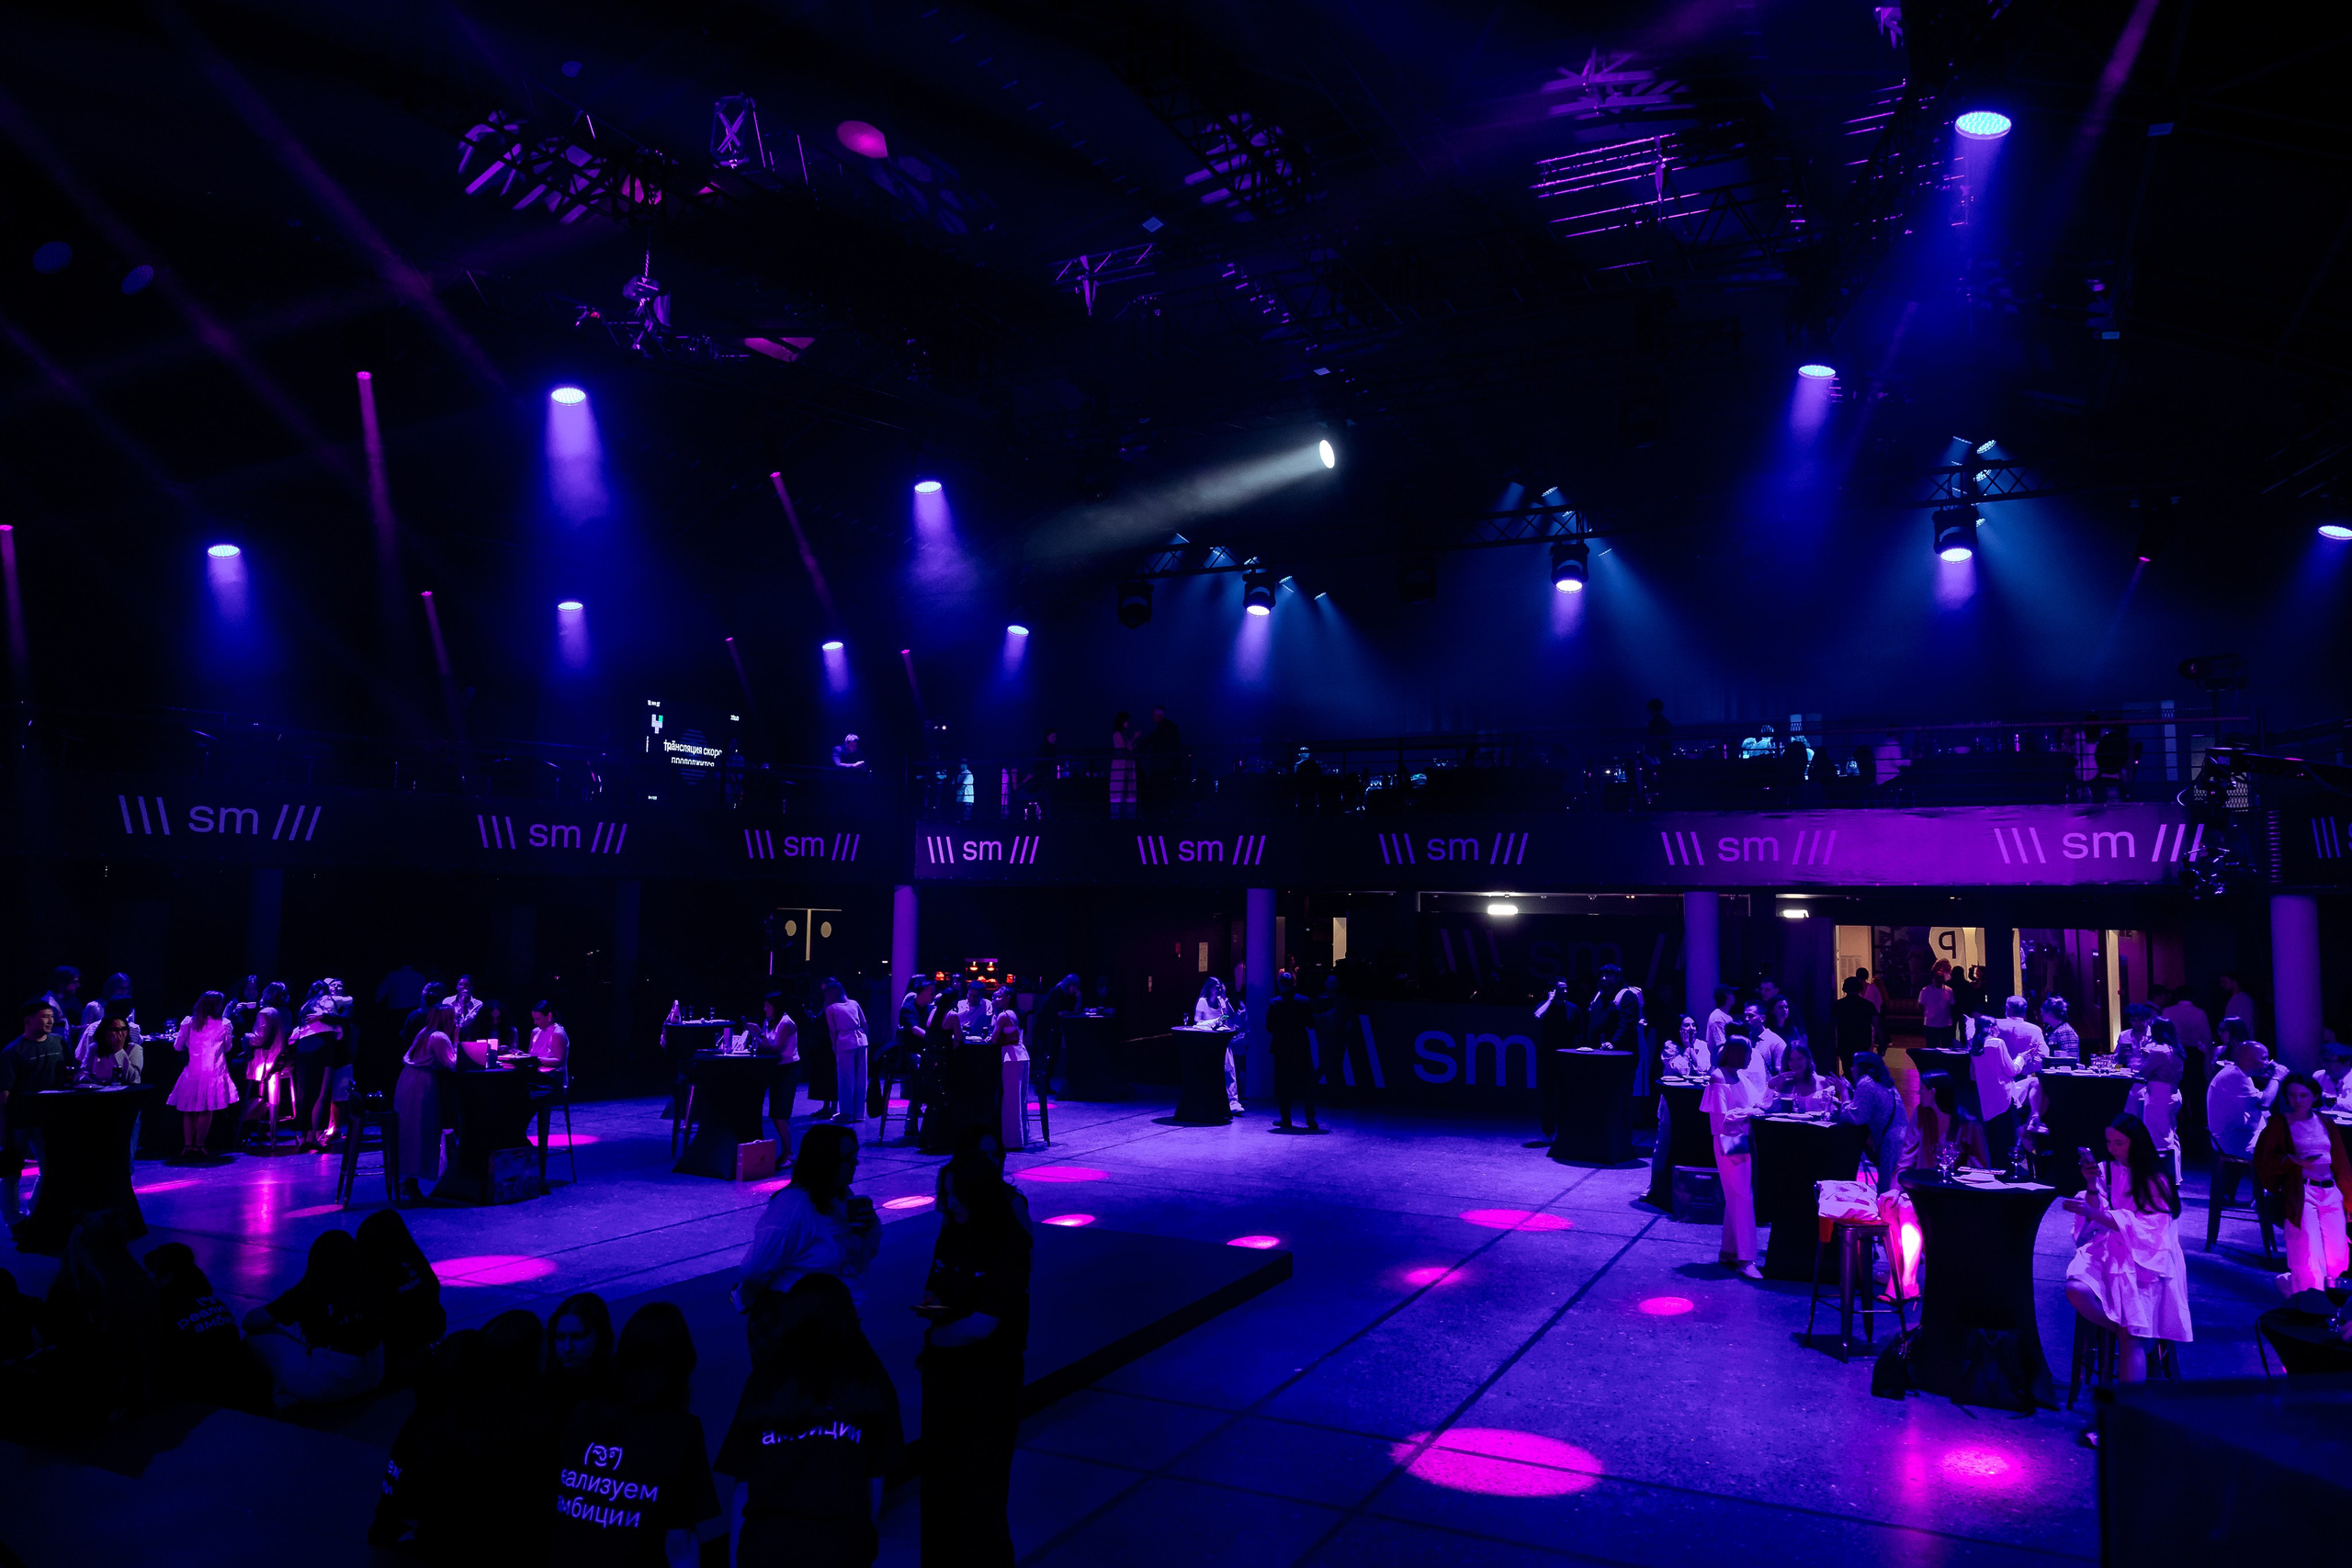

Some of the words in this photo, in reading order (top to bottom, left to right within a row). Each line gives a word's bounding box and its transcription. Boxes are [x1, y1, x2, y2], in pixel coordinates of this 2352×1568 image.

[189, 807, 258, 835] sm
[529, 824, 582, 849] sm
[785, 836, 824, 857] sm
[1427, 838, 1478, 861] sm
[1719, 834, 1781, 862] sm
[2063, 830, 2135, 860] sm
[963, 840, 1002, 862] sm
[1179, 840, 1223, 862] sm
[1414, 1031, 1537, 1089] sm
[560, 1468, 660, 1503] еализуем
